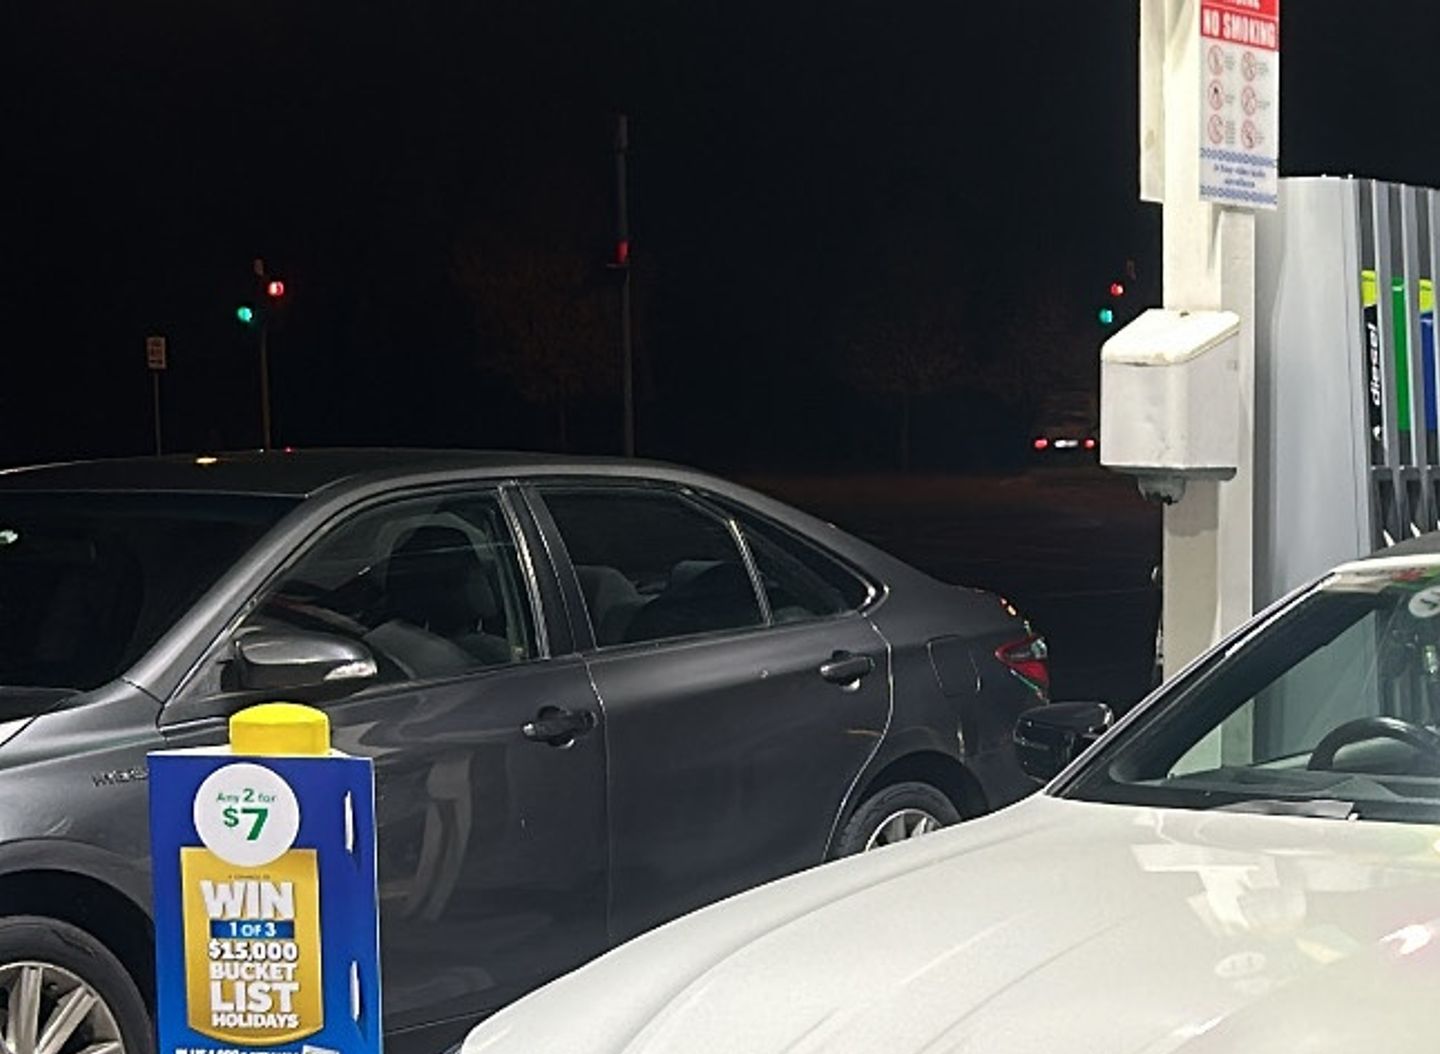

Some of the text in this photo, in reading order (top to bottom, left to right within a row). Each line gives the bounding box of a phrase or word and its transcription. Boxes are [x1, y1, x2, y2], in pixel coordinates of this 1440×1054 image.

[1203, 8, 1275, 48] NO SMOKING
[1367, 322, 1381, 407] diesel
[216, 788, 277, 804] Any 2 for
[222, 805, 269, 841] $7
[200, 880, 295, 919] WIN
[230, 922, 277, 937] 1 OF 3
[208, 938, 299, 962] $15,000
[210, 962, 298, 981] BUCKET
[210, 981, 300, 1013] LIST
[211, 1012, 300, 1029] HOLIDAYS
